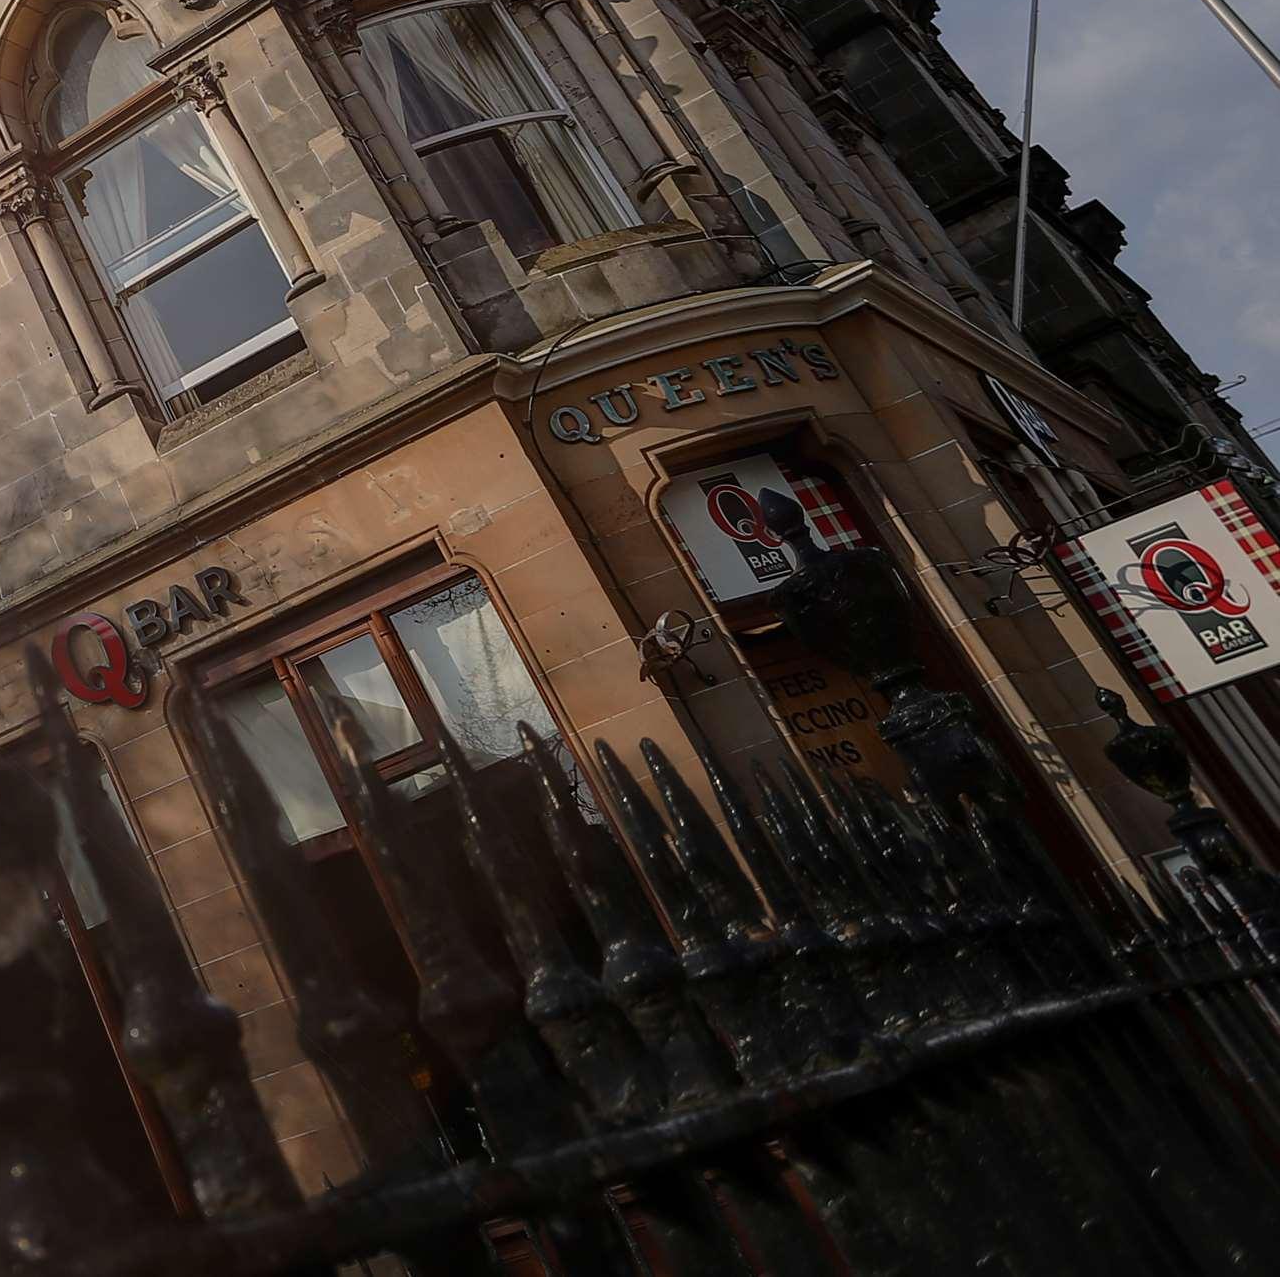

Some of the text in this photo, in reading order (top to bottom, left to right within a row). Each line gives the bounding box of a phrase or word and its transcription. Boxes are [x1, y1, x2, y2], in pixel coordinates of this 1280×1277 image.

[548, 338, 839, 445] QUEEN'S
[706, 483, 786, 550] Q
[747, 550, 783, 570] BAR
[1140, 537, 1252, 618] Q
[51, 566, 245, 709] Q BAR
[1199, 619, 1251, 648] BAR
[766, 668, 828, 701] FEES
[784, 697, 869, 735] CCINO
[806, 739, 863, 769] NKS
